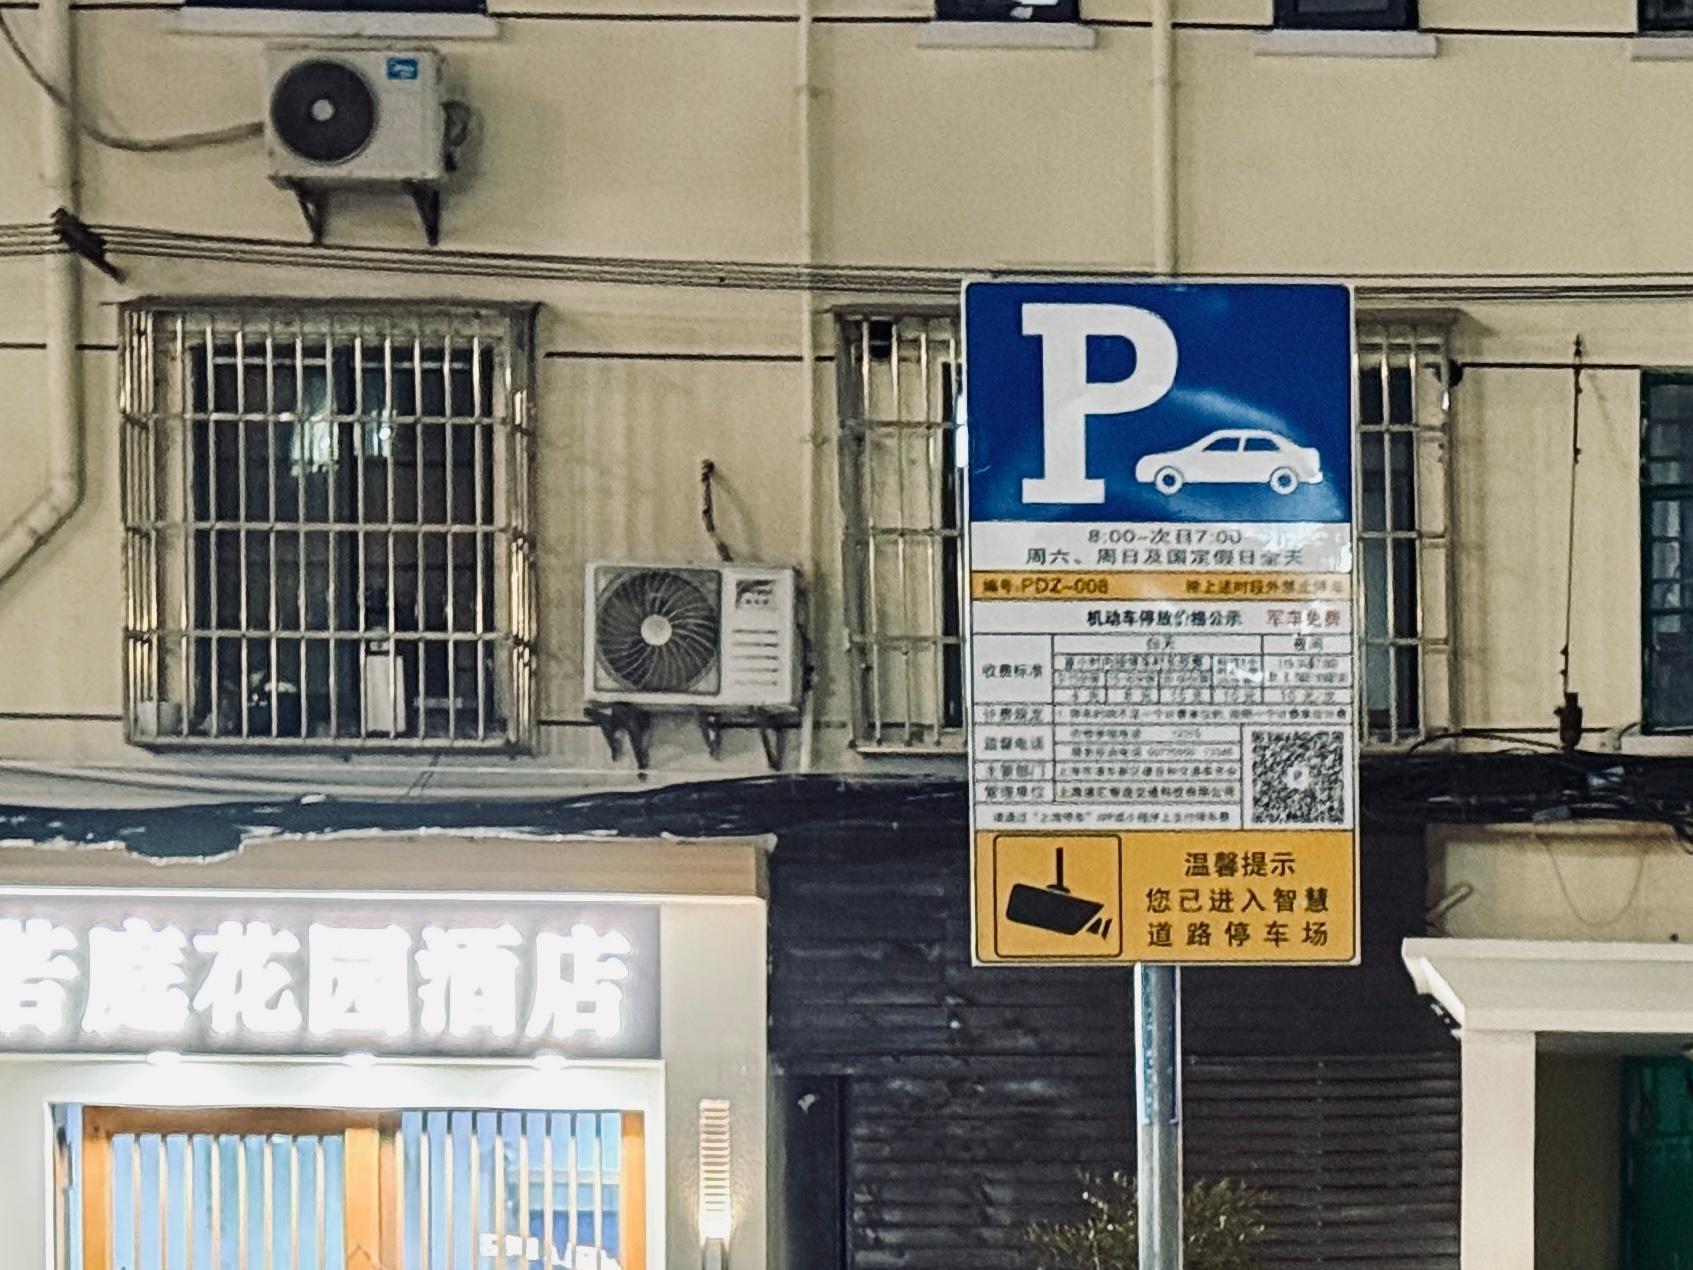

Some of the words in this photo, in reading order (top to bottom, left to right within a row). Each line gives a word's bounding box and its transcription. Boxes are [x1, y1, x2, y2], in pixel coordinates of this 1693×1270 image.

[1021, 302, 1179, 504] P
[1025, 548, 1304, 566] 周六、周日及国定假日全天
[1087, 609, 1243, 628] 机动车停放价格公示
[1184, 851, 1296, 878] 温馨提示
[1145, 887, 1330, 914] 您已进入智慧
[1147, 921, 1329, 948] 道路停车场
